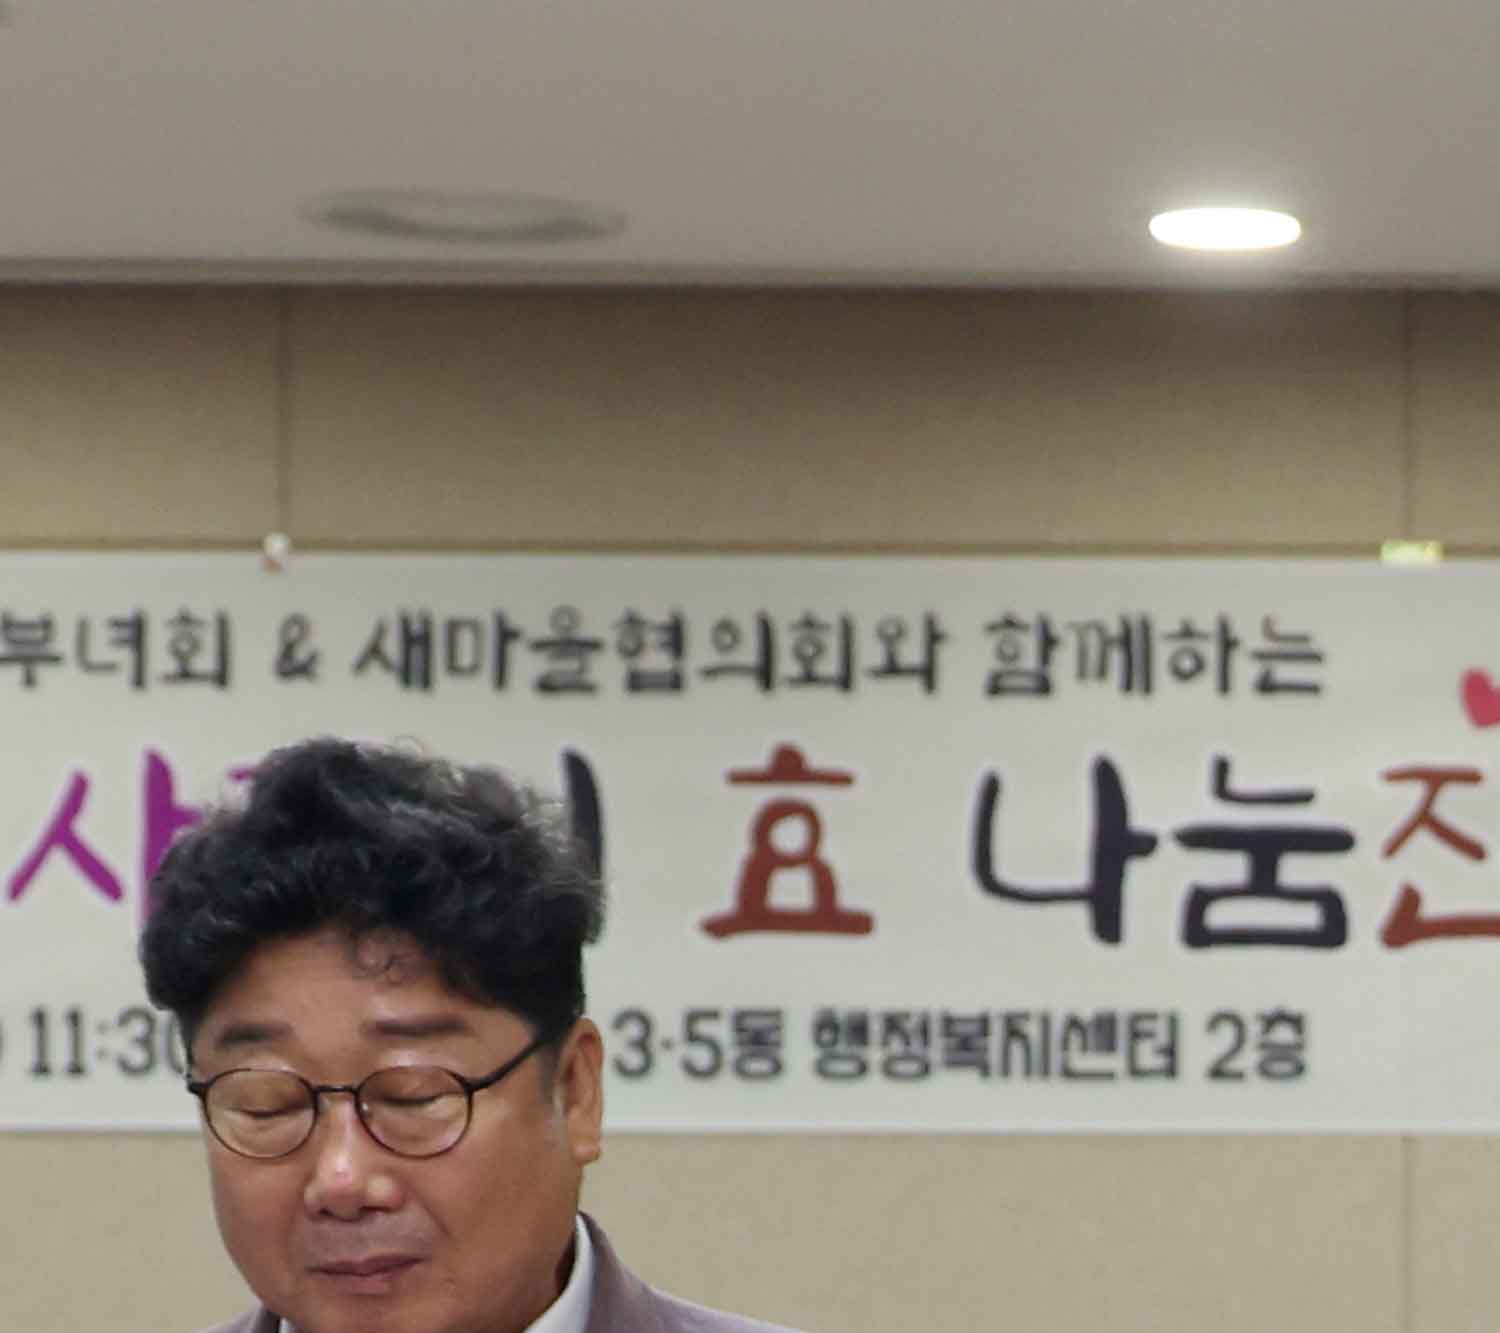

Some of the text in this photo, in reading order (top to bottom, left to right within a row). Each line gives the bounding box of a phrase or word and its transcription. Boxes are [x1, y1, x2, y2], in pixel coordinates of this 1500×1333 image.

[0, 604, 1327, 699] 부녀회 & 새마을협의회와 함께하는
[699, 743, 875, 939] 효
[812, 1008, 1179, 1081] 행정복지센터
[1205, 1008, 1306, 1081] 2층
